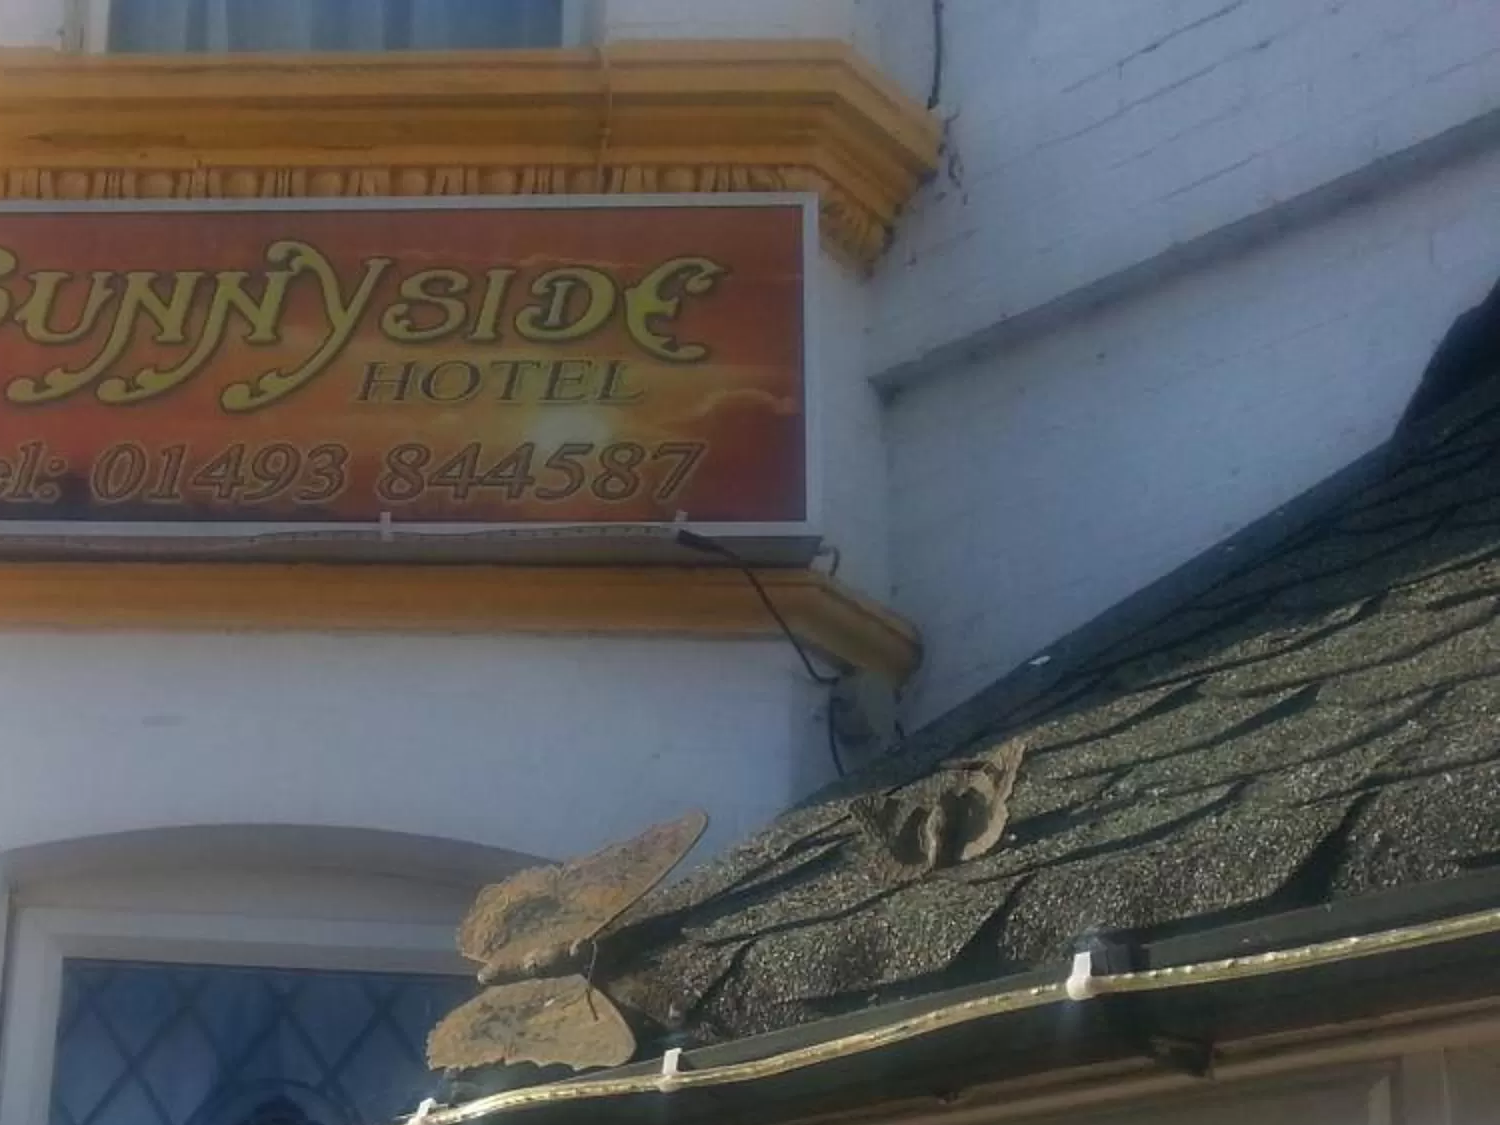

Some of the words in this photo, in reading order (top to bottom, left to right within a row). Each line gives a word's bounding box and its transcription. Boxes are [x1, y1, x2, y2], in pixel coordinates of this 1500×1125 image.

[360, 359, 643, 401] HOTEL
[90, 441, 349, 503] 01493
[375, 441, 708, 503] 844587
